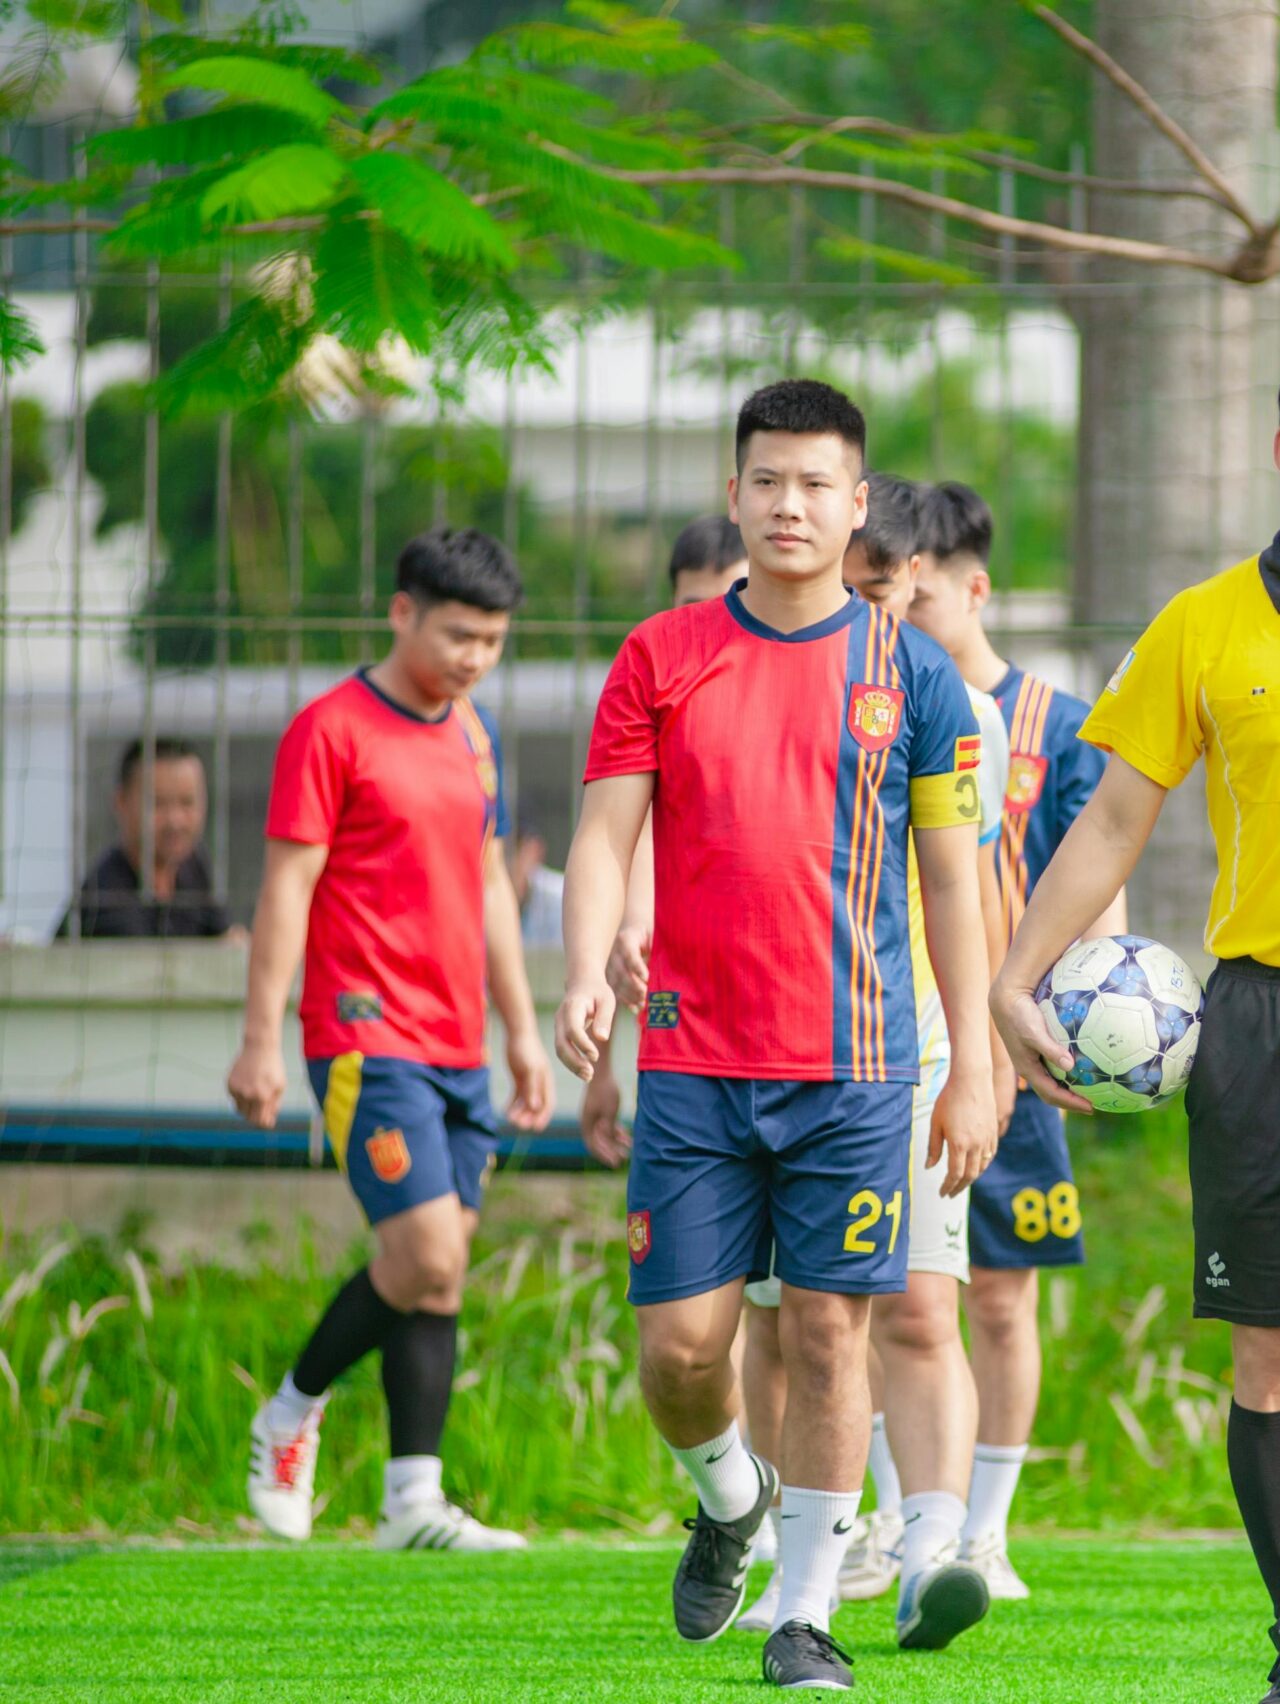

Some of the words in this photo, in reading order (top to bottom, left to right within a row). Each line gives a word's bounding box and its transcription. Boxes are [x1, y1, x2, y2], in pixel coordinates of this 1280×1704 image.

[842, 1189, 903, 1255] 21
[1011, 1181, 1082, 1243] 88
[1205, 1276, 1230, 1288] egan
